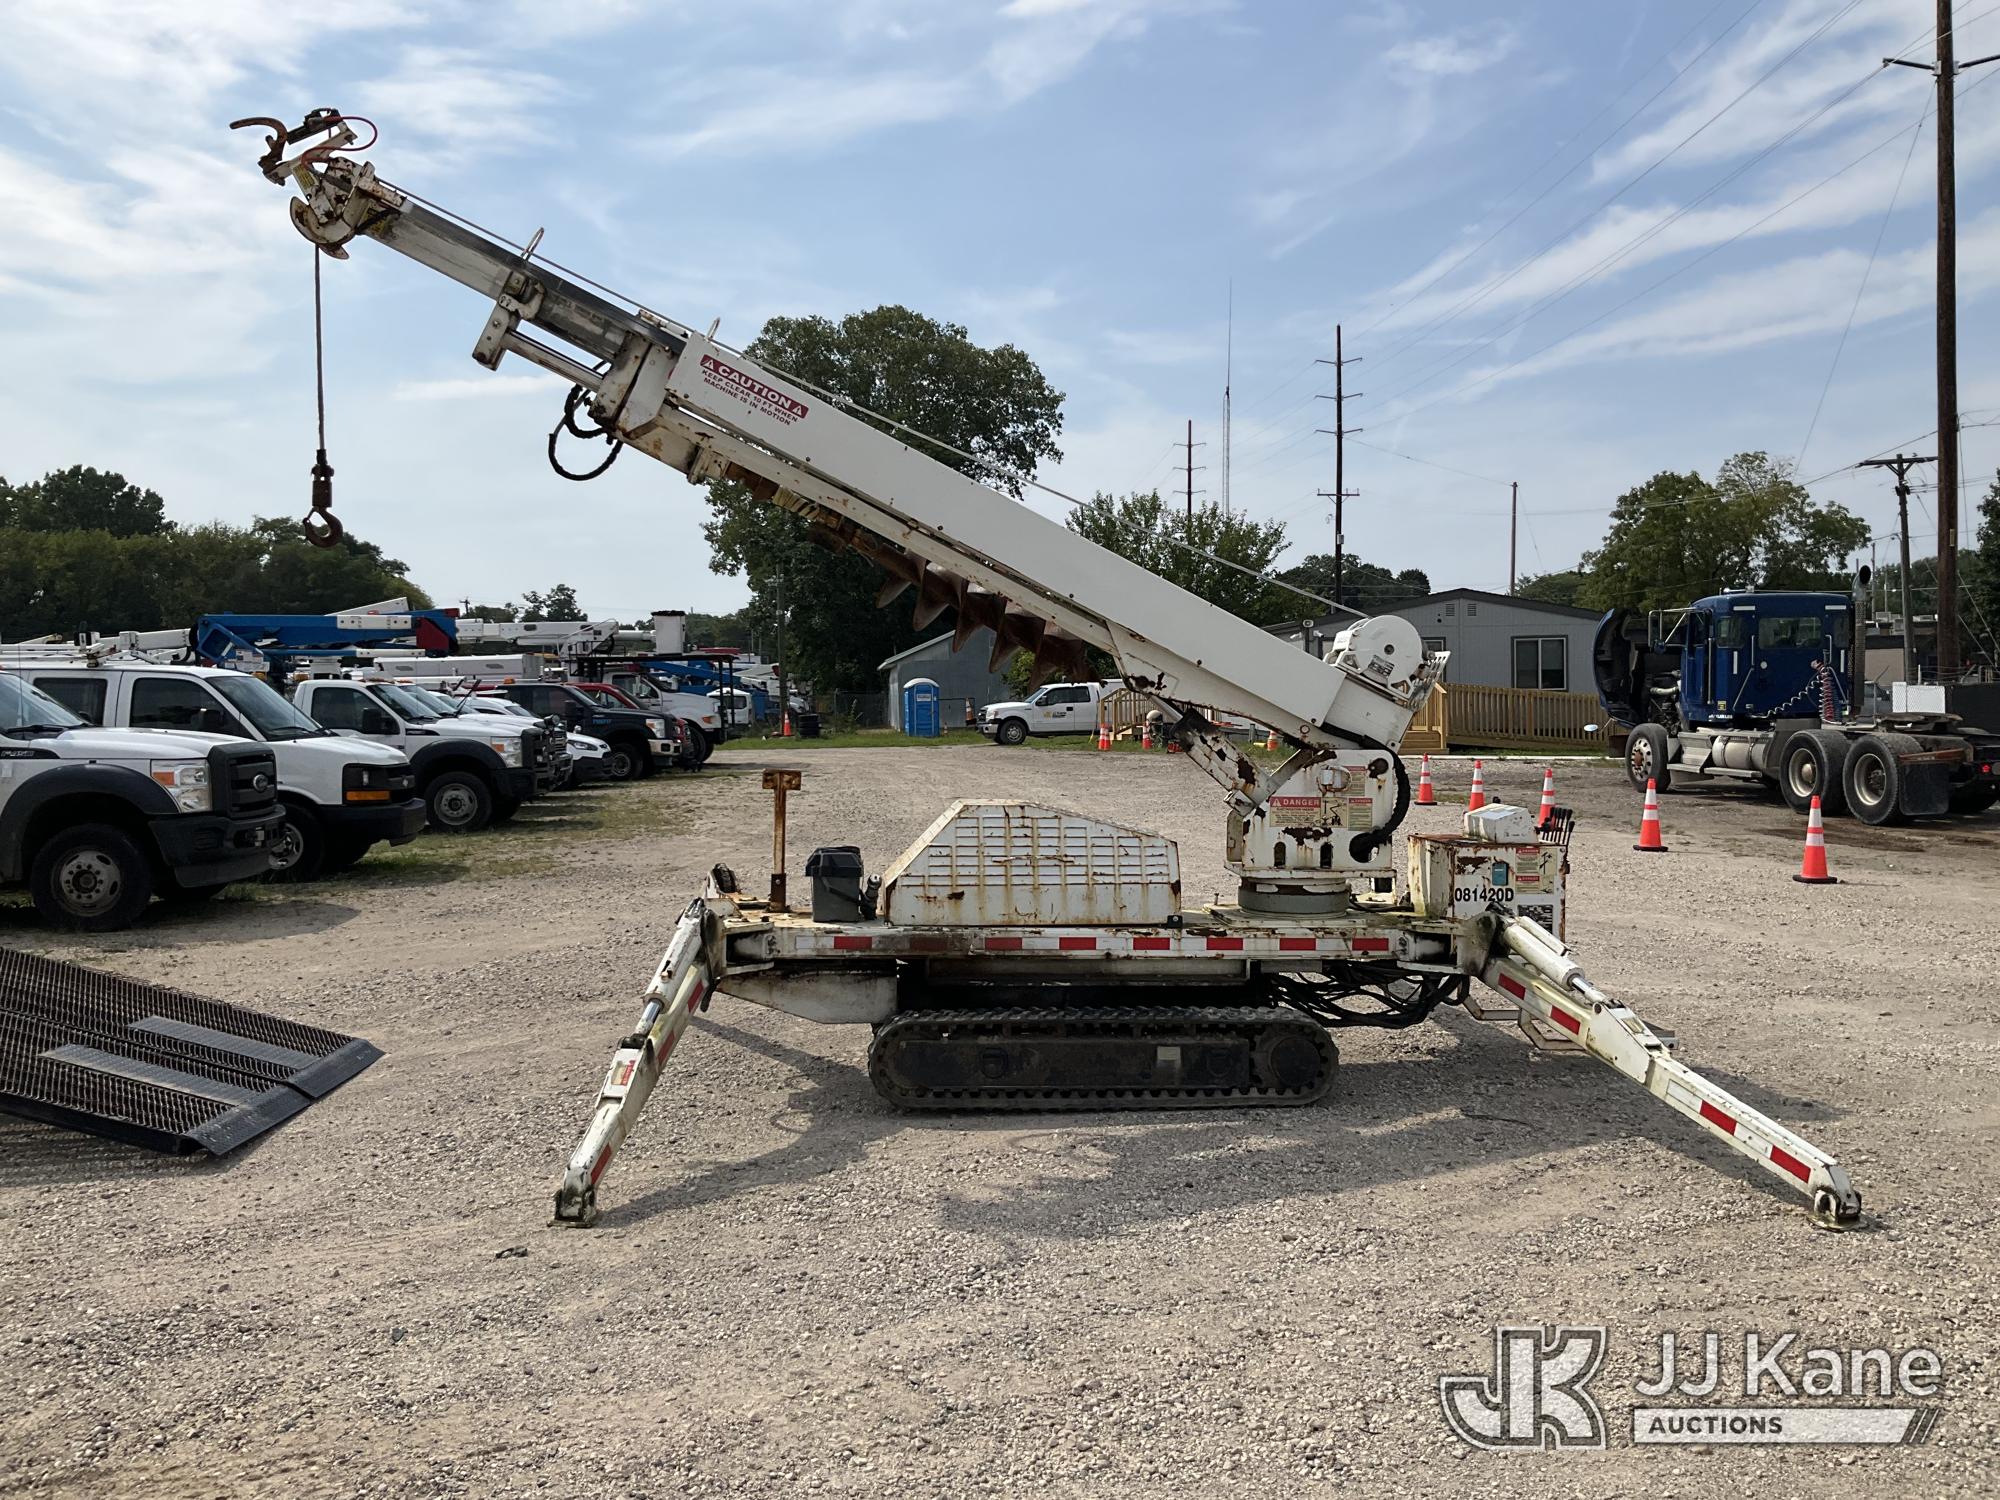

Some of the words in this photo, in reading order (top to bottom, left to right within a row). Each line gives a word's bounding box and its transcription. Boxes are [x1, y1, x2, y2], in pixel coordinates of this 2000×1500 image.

[702, 369, 724, 383] KEEP
[725, 381, 751, 398] CLEAR
[753, 395, 762, 403] 10
[763, 400, 774, 410] FT
[774, 405, 798, 423] WHEN
[703, 377, 741, 399] MACHINE
[740, 396, 748, 404] IS
[749, 400, 758, 409] IN
[760, 406, 791, 426] MOTION
[718, 364, 793, 409] CAUTION
[1283, 798, 1320, 806] DANGER
[1454, 887, 1514, 902] 081420D
